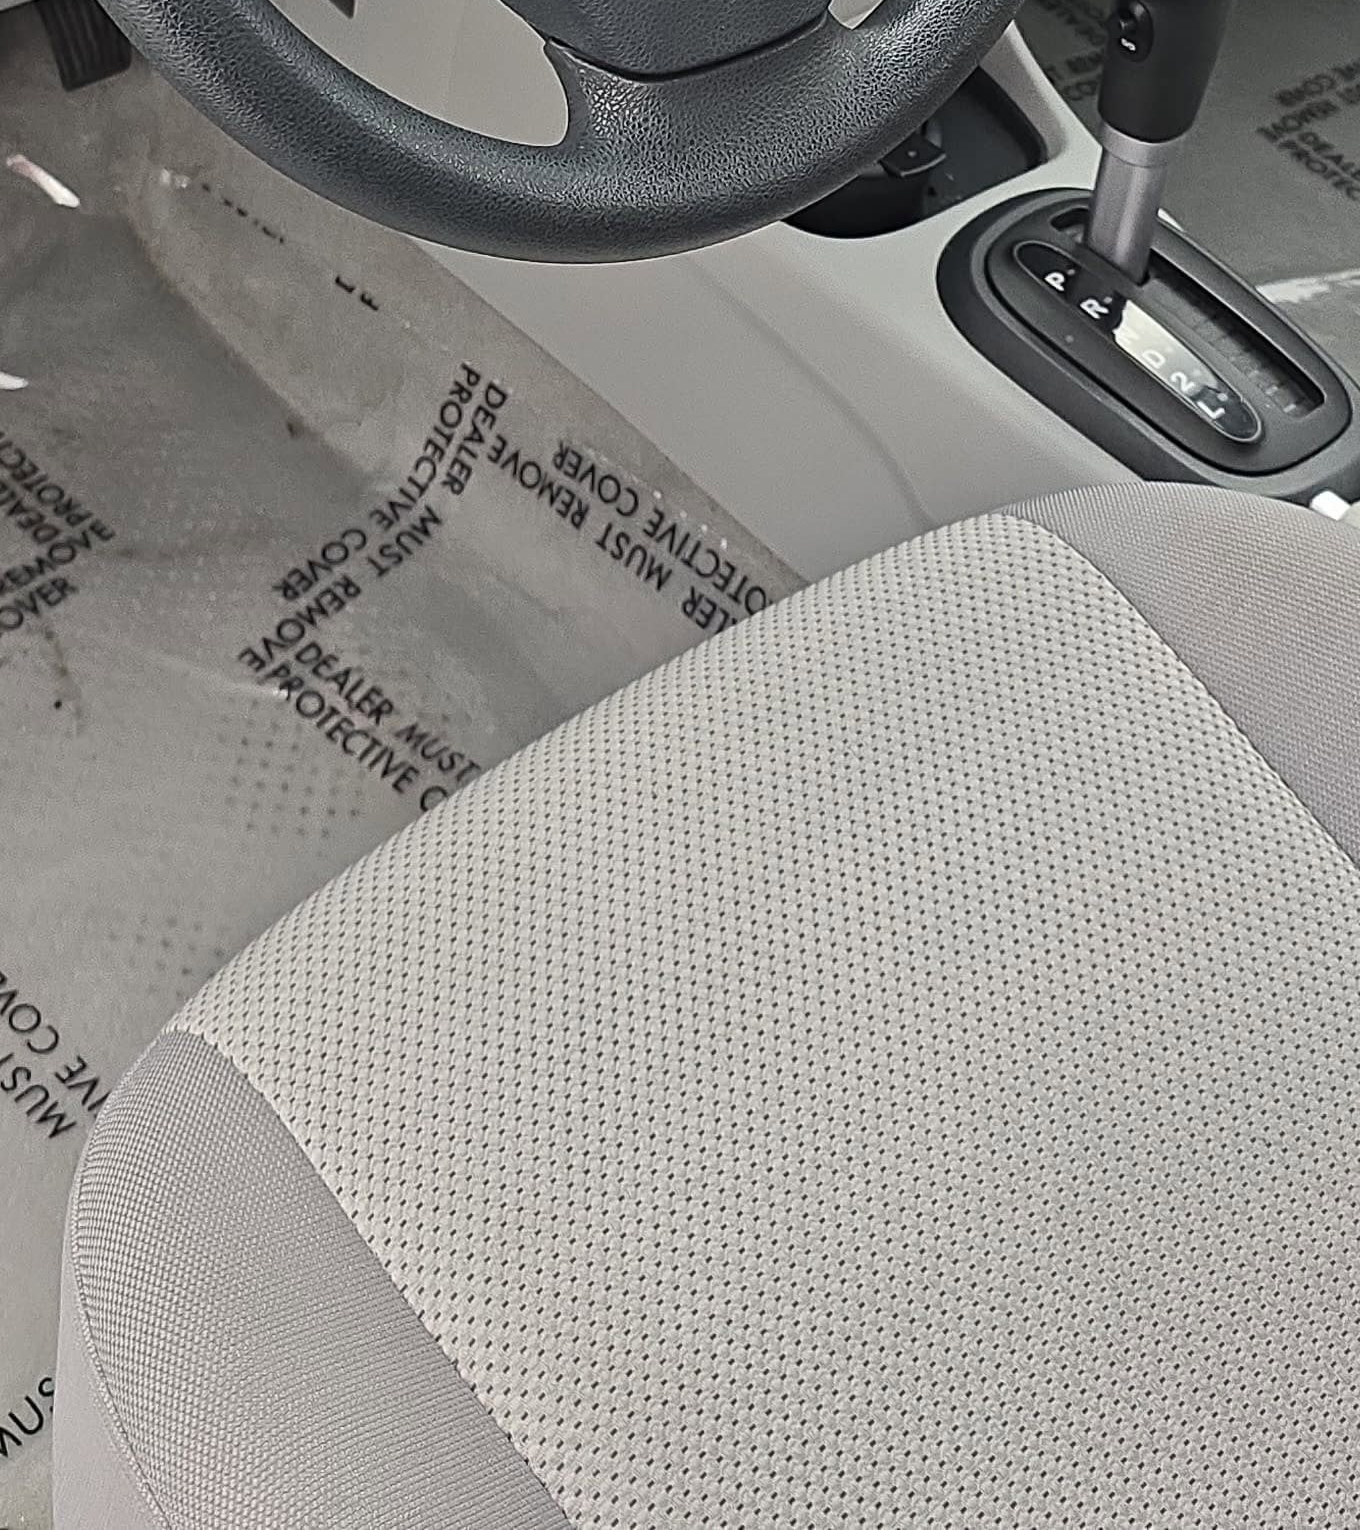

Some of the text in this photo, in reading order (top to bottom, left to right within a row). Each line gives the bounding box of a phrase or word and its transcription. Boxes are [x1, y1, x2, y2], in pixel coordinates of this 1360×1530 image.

[1044, 271, 1066, 292] P
[1079, 298, 1109, 319] R
[1142, 349, 1167, 369] D
[1170, 371, 1197, 397] 2
[1196, 401, 1226, 420] L
[272, 362, 481, 604] PROTECTIVE COVER
[487, 439, 590, 530] REMOVE
[551, 441, 640, 518] COVER
[238, 380, 508, 672] DEALER MUST REMOVE
[596, 521, 671, 593] MUST
[257, 664, 418, 797] PROTECTIVE
[296, 635, 481, 786] DEALER MUST
